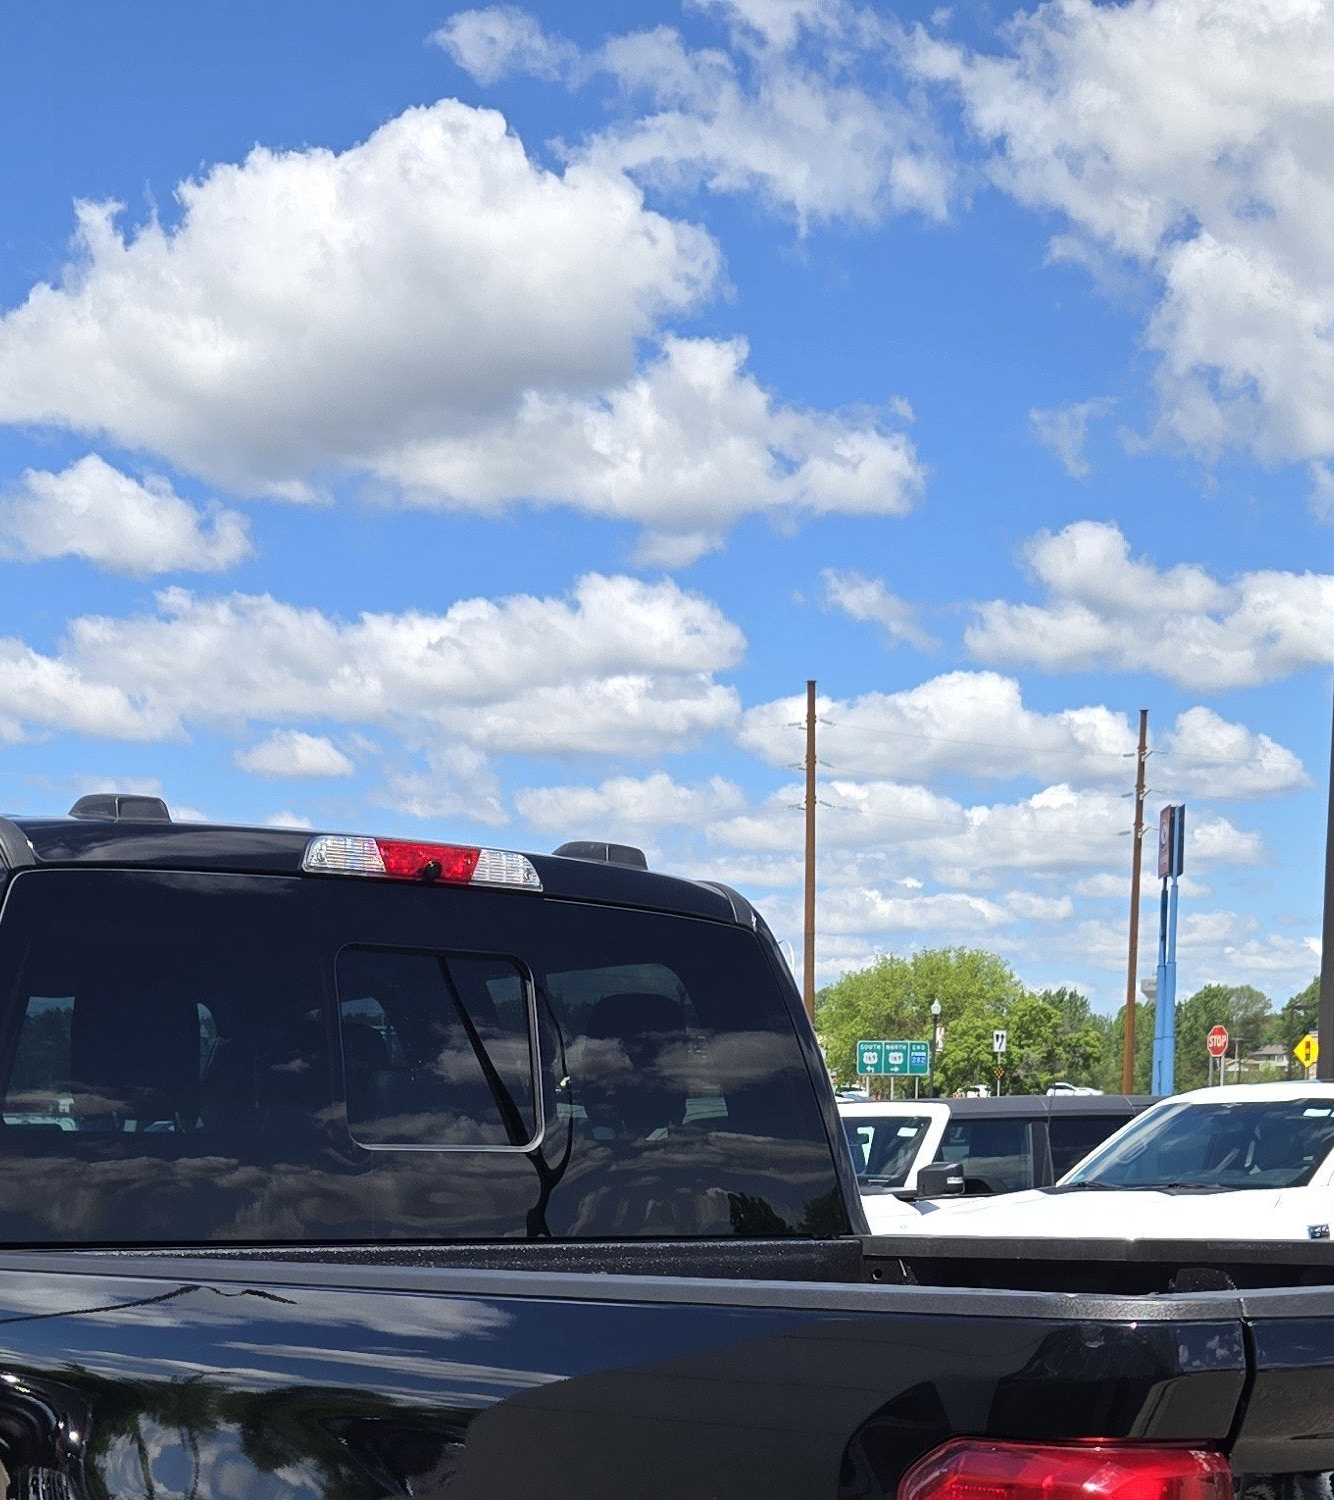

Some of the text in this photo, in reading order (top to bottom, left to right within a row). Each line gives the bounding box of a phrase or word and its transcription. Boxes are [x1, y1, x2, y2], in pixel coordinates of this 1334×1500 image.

[1208, 1035, 1227, 1048] STOP
[866, 1054, 876, 1062] 169
[892, 1054, 902, 1062] 169
